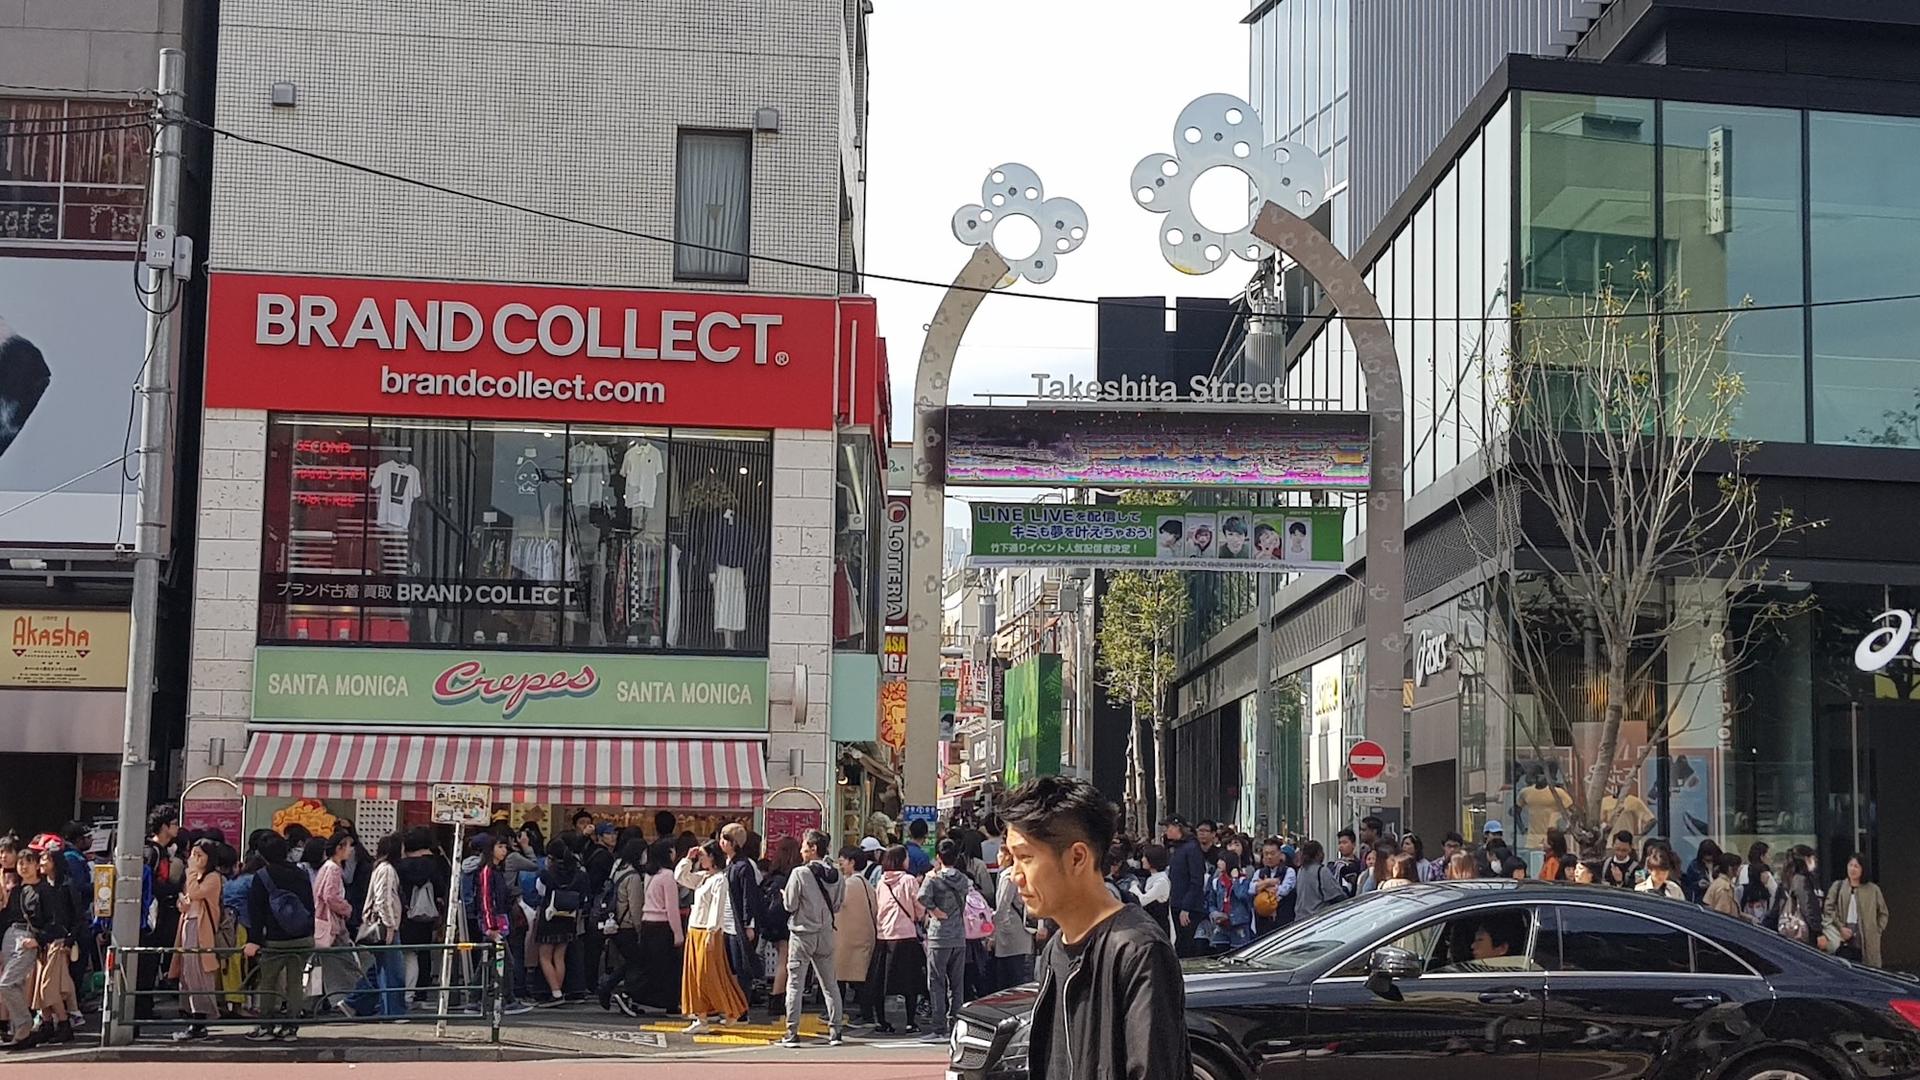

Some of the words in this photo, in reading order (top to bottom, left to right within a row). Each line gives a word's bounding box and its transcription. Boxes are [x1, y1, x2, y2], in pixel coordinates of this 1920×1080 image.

[0, 206, 53, 233] afé
[255, 292, 485, 352] BRAND
[381, 365, 666, 403] brandcollect.com
[1031, 373, 1178, 402] Takeshita
[1189, 374, 1286, 403] Street
[296, 439, 353, 454] SECOND
[978, 507, 1024, 522] LINE
[1029, 508, 1142, 524] LIVEを配信して
[886, 526, 905, 618] LOTTERIA
[276, 582, 360, 600] ブランド古着
[363, 584, 393, 600] 買取
[396, 583, 472, 602] BRAND
[12, 615, 91, 647] Akasha
[268, 672, 329, 696] SANTA
[334, 674, 409, 698] MONICA
[432, 660, 600, 718] Crepes
[616, 681, 677, 704] SANTA
[681, 683, 754, 706] MONICA
